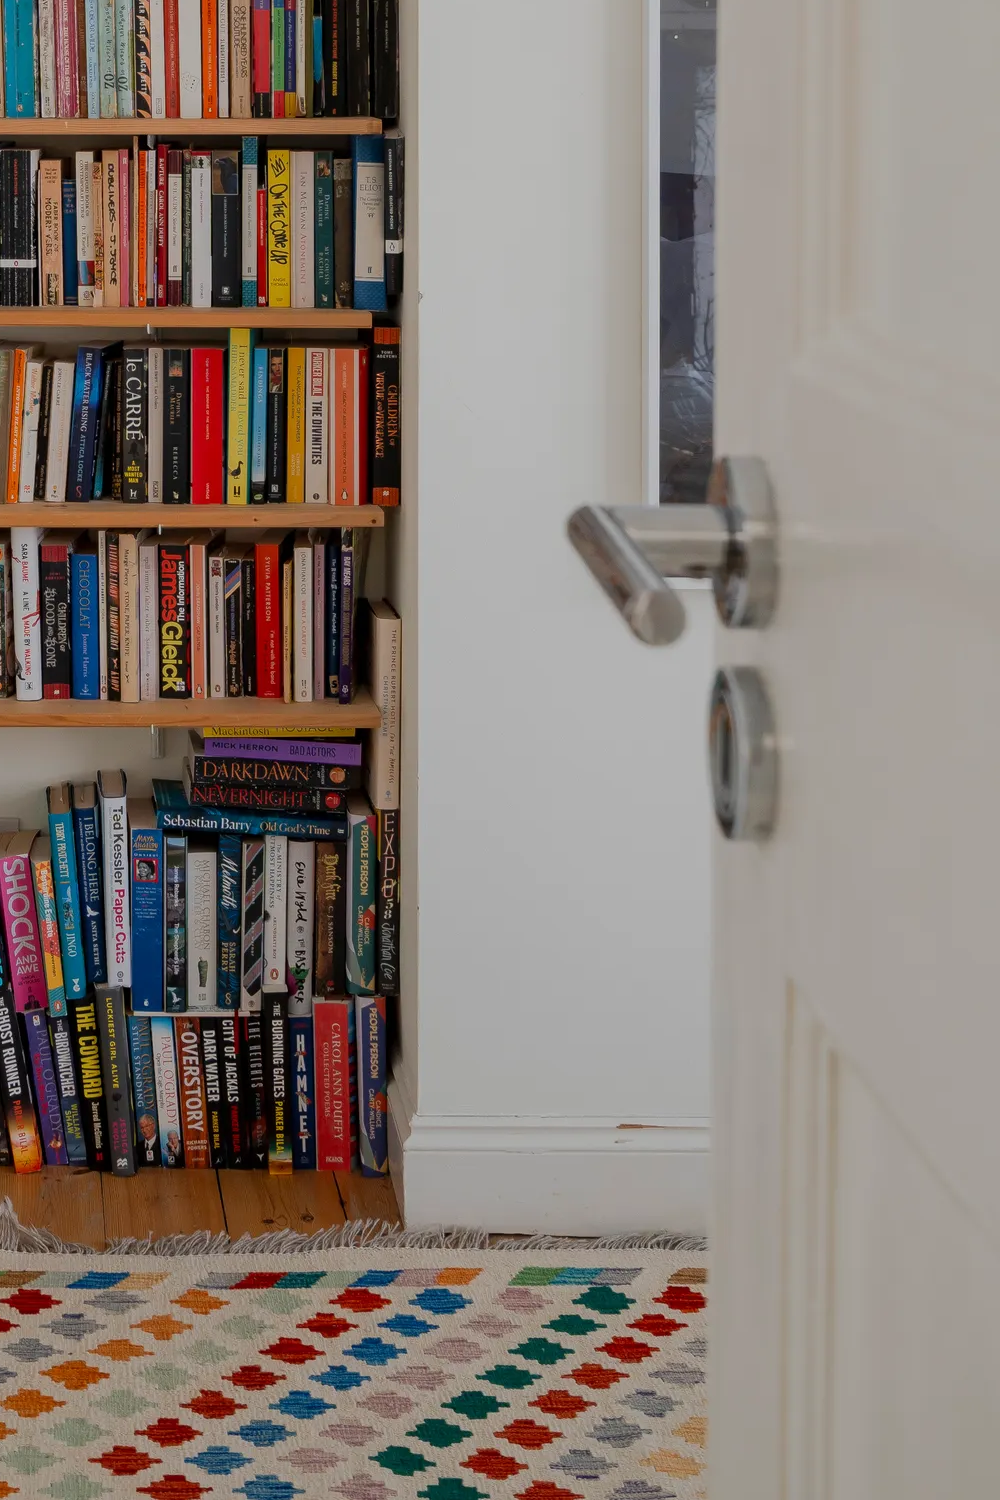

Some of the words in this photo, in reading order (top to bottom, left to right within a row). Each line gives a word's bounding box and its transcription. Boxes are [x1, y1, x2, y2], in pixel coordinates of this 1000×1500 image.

[273, 201, 283, 218] THE
[271, 250, 288, 265] UP
[126, 358, 142, 371] le
[312, 352, 323, 376] PARKER
[83, 379, 91, 404] WATER
[313, 378, 323, 395] BILAL
[81, 406, 89, 431] RISING
[126, 377, 144, 440] CARRÉ
[312, 401, 322, 417] THE
[312, 419, 322, 464] DIVINITIES
[79, 560, 90, 628] CHOCOLAT
[161, 550, 181, 622] James
[82, 634, 90, 654] Joanne
[161, 622, 183, 691] Gleick
[212, 742, 237, 750] MICK
[239, 743, 278, 752] HERRON
[290, 745, 307, 756] BAD
[308, 747, 336, 758] ACTORS
[202, 761, 310, 782] DARKDAWN
[192, 784, 308, 807] NEVERNIGHT
[113, 806, 123, 830] Ted
[163, 814, 217, 829] Sebastian
[220, 817, 251, 832] Barry
[260, 821, 277, 832] Old
[280, 823, 305, 833] God's
[308, 824, 330, 835] Time
[113, 834, 124, 885] Kessler
[2, 859, 36, 957] SHOCK
[113, 889, 125, 930] Paper
[16, 955, 38, 964] AND
[115, 932, 126, 963] Cuts
[17, 965, 39, 975] AWE
[75, 1003, 94, 1032] THE
[222, 1020, 234, 1042] CITY
[202, 1030, 217, 1060] DARK
[225, 1046, 235, 1059] OF
[2, 1049, 22, 1096] RUNNER
[78, 1036, 102, 1098] COWARD
[181, 1032, 203, 1132] OVERSTORY
[205, 1064, 220, 1102] WATER
[226, 1062, 239, 1102] JACKALS
